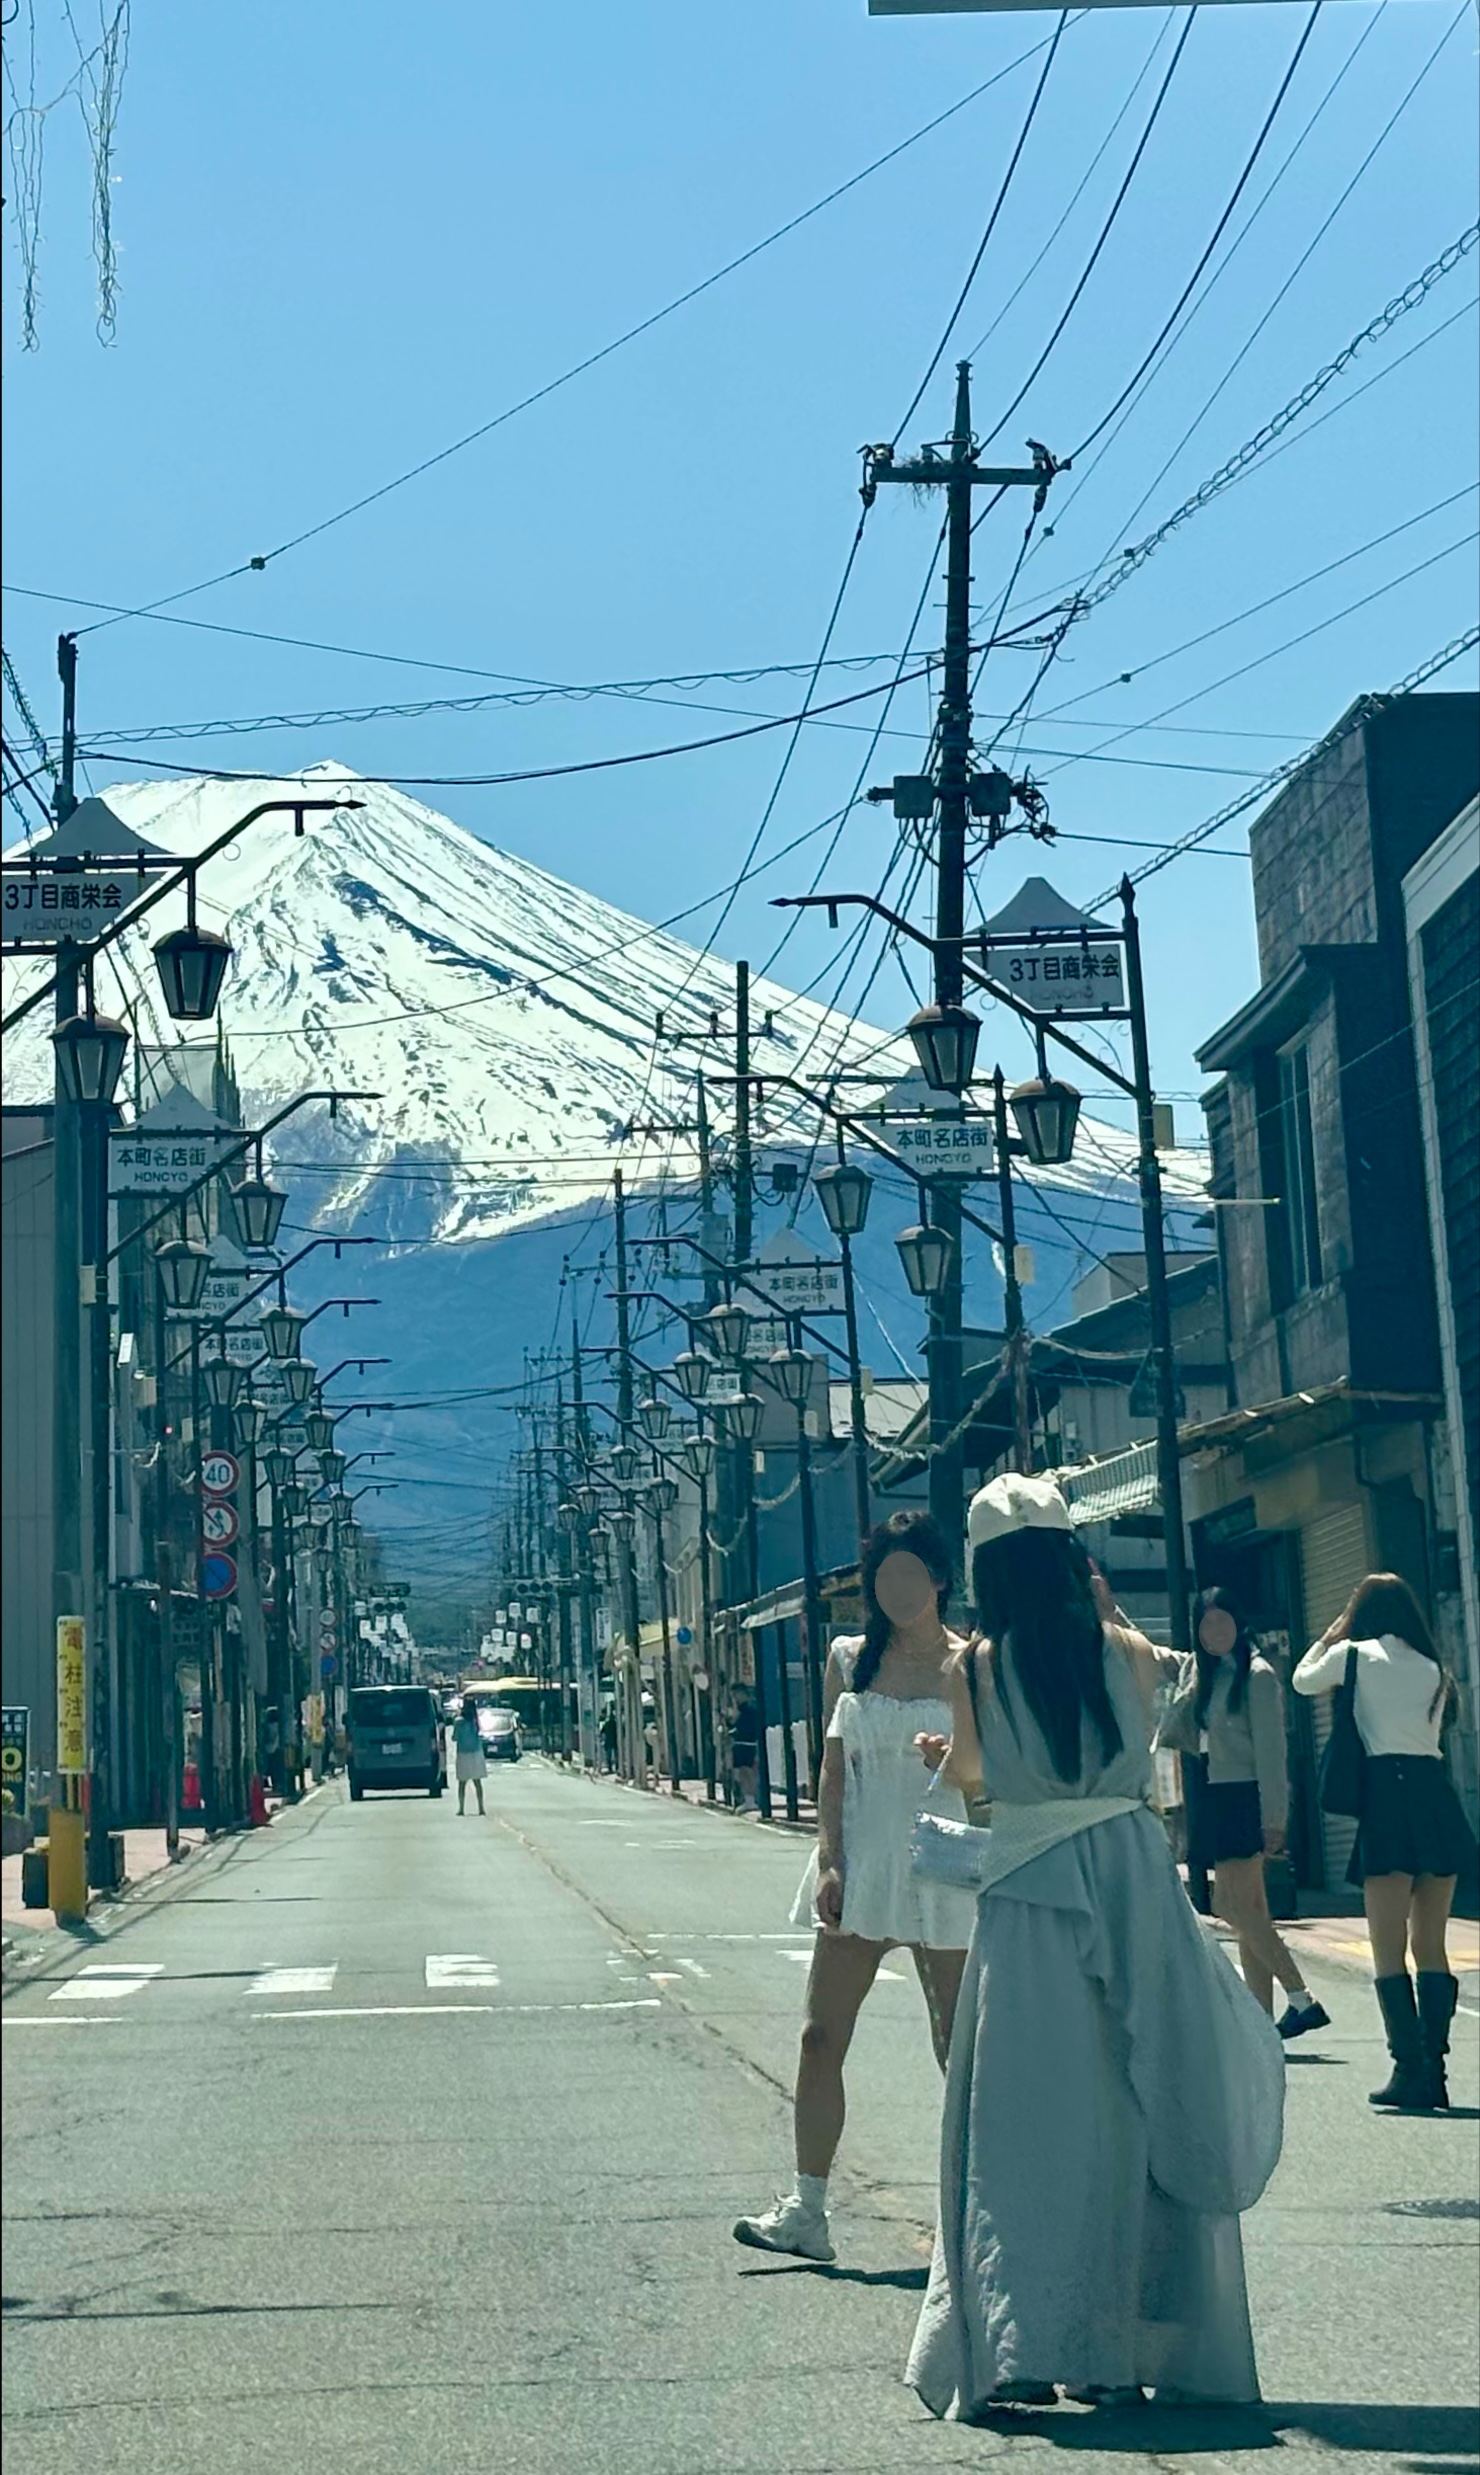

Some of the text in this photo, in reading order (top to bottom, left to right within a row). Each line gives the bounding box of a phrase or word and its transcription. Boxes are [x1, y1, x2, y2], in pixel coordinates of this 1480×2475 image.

[5, 883, 122, 910] 3丁目商栄会
[1009, 953, 1120, 982] 3丁目商栄会
[897, 1126, 988, 1149] 本町名店街
[117, 1147, 206, 1167] 本町名店街
[769, 1274, 838, 1291] 本町名店街
[206, 1464, 230, 1484] 40
[64, 1626, 83, 1752] 電柱注意
